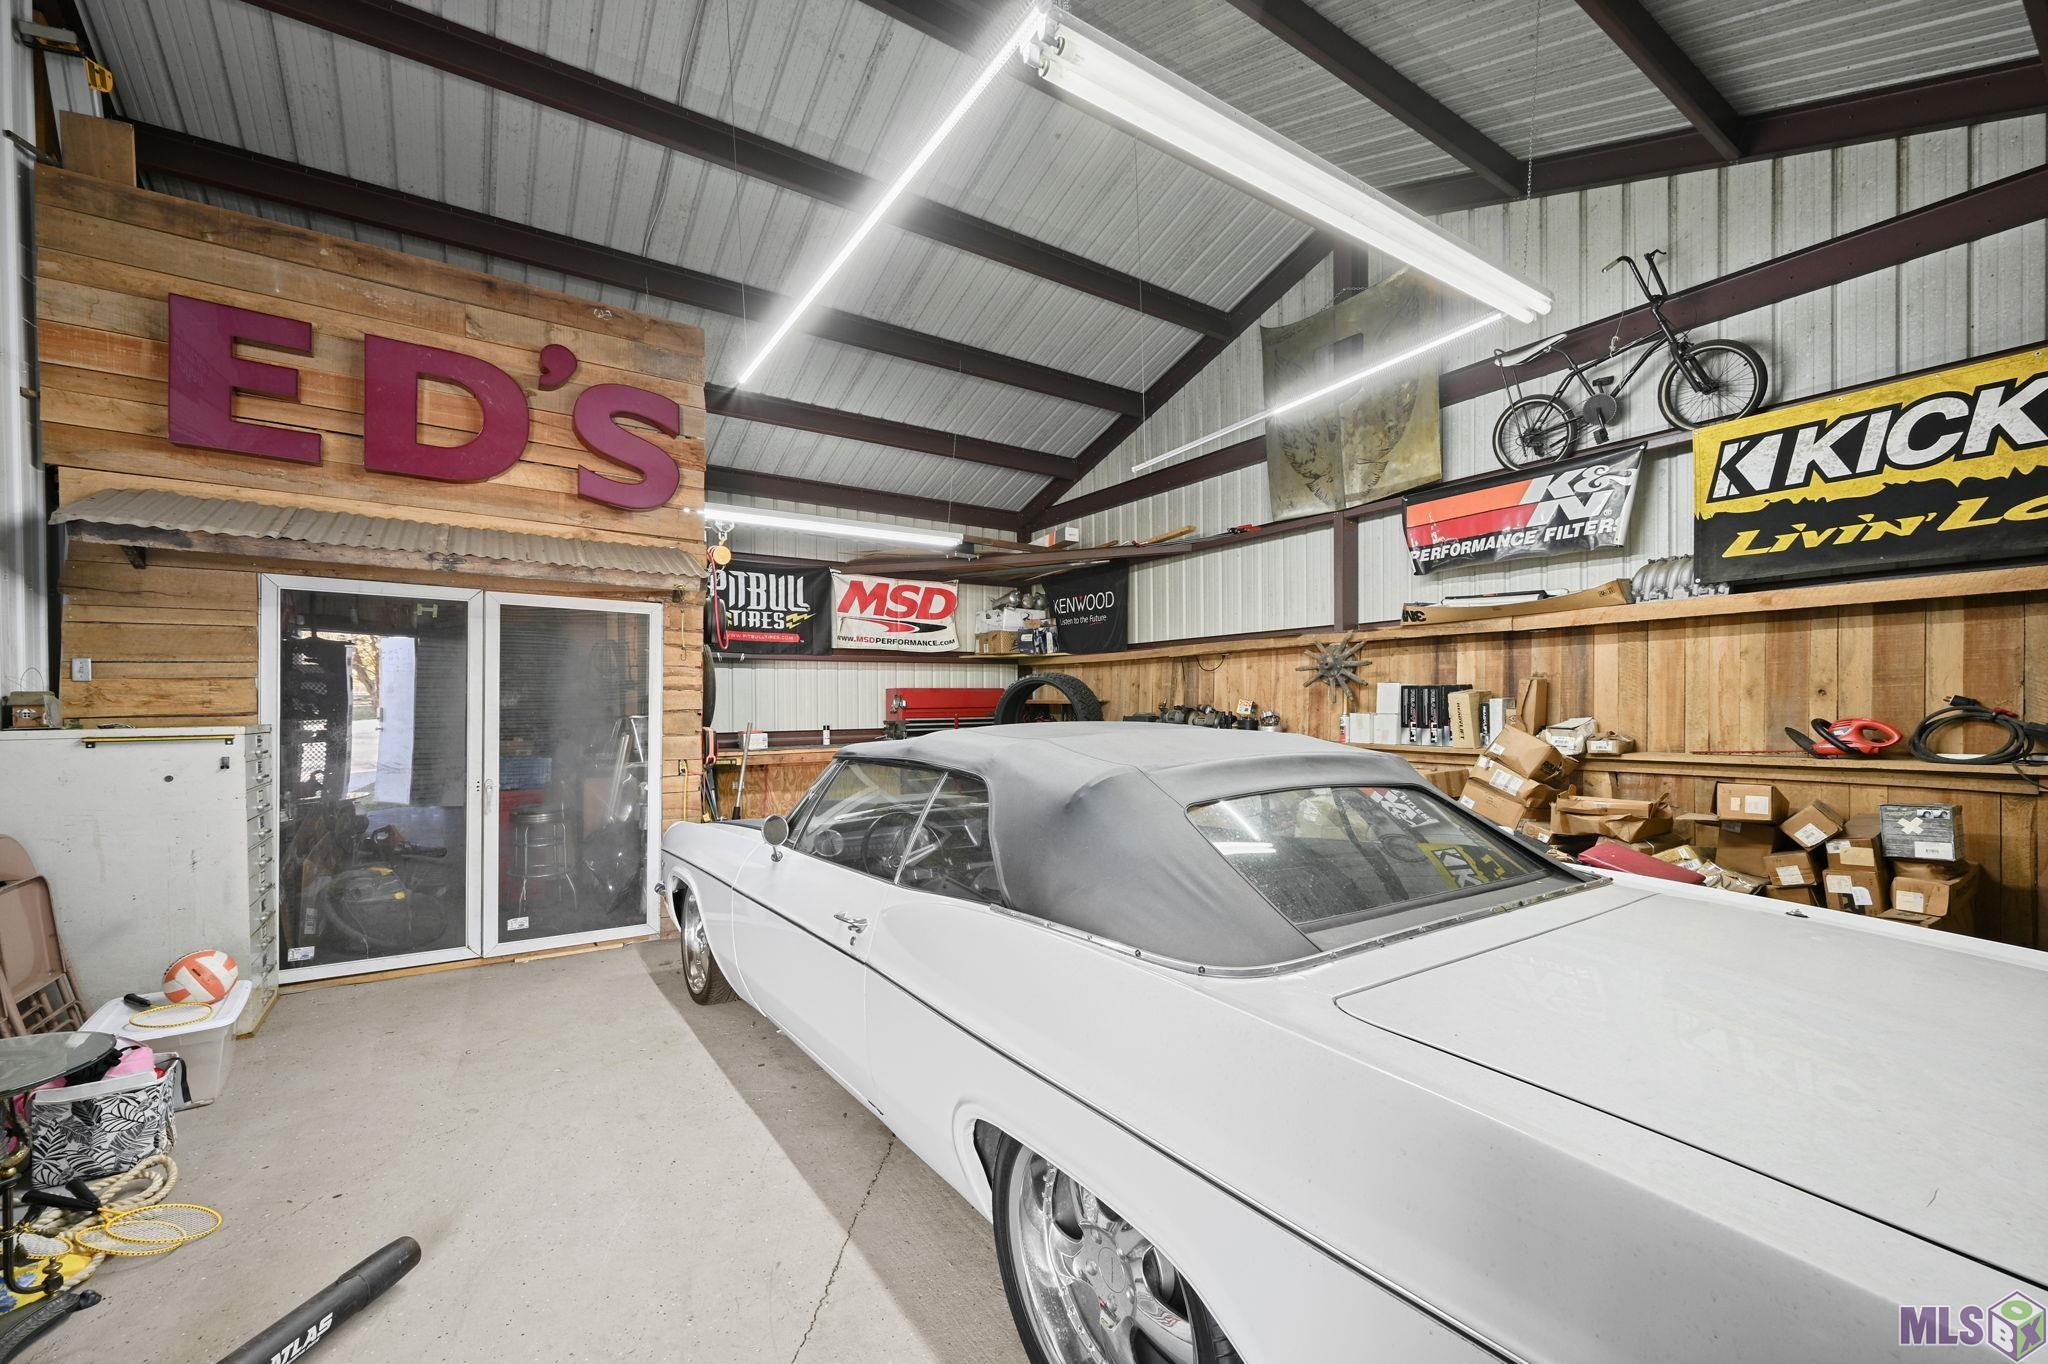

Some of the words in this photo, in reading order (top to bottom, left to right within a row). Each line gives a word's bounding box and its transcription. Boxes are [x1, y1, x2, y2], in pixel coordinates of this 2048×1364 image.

[169, 293, 681, 510] ED'S
[1519, 464, 1637, 528] K&N
[1410, 530, 1537, 561] PERFORMANCE
[709, 569, 811, 612] PITBULL
[837, 580, 957, 620] MSD
[1053, 591, 1115, 614] KENWOOD
[729, 609, 785, 630] TIRES
[1074, 617, 1080, 625] to
[1080, 616, 1089, 624] the
[1090, 614, 1107, 623] Future
